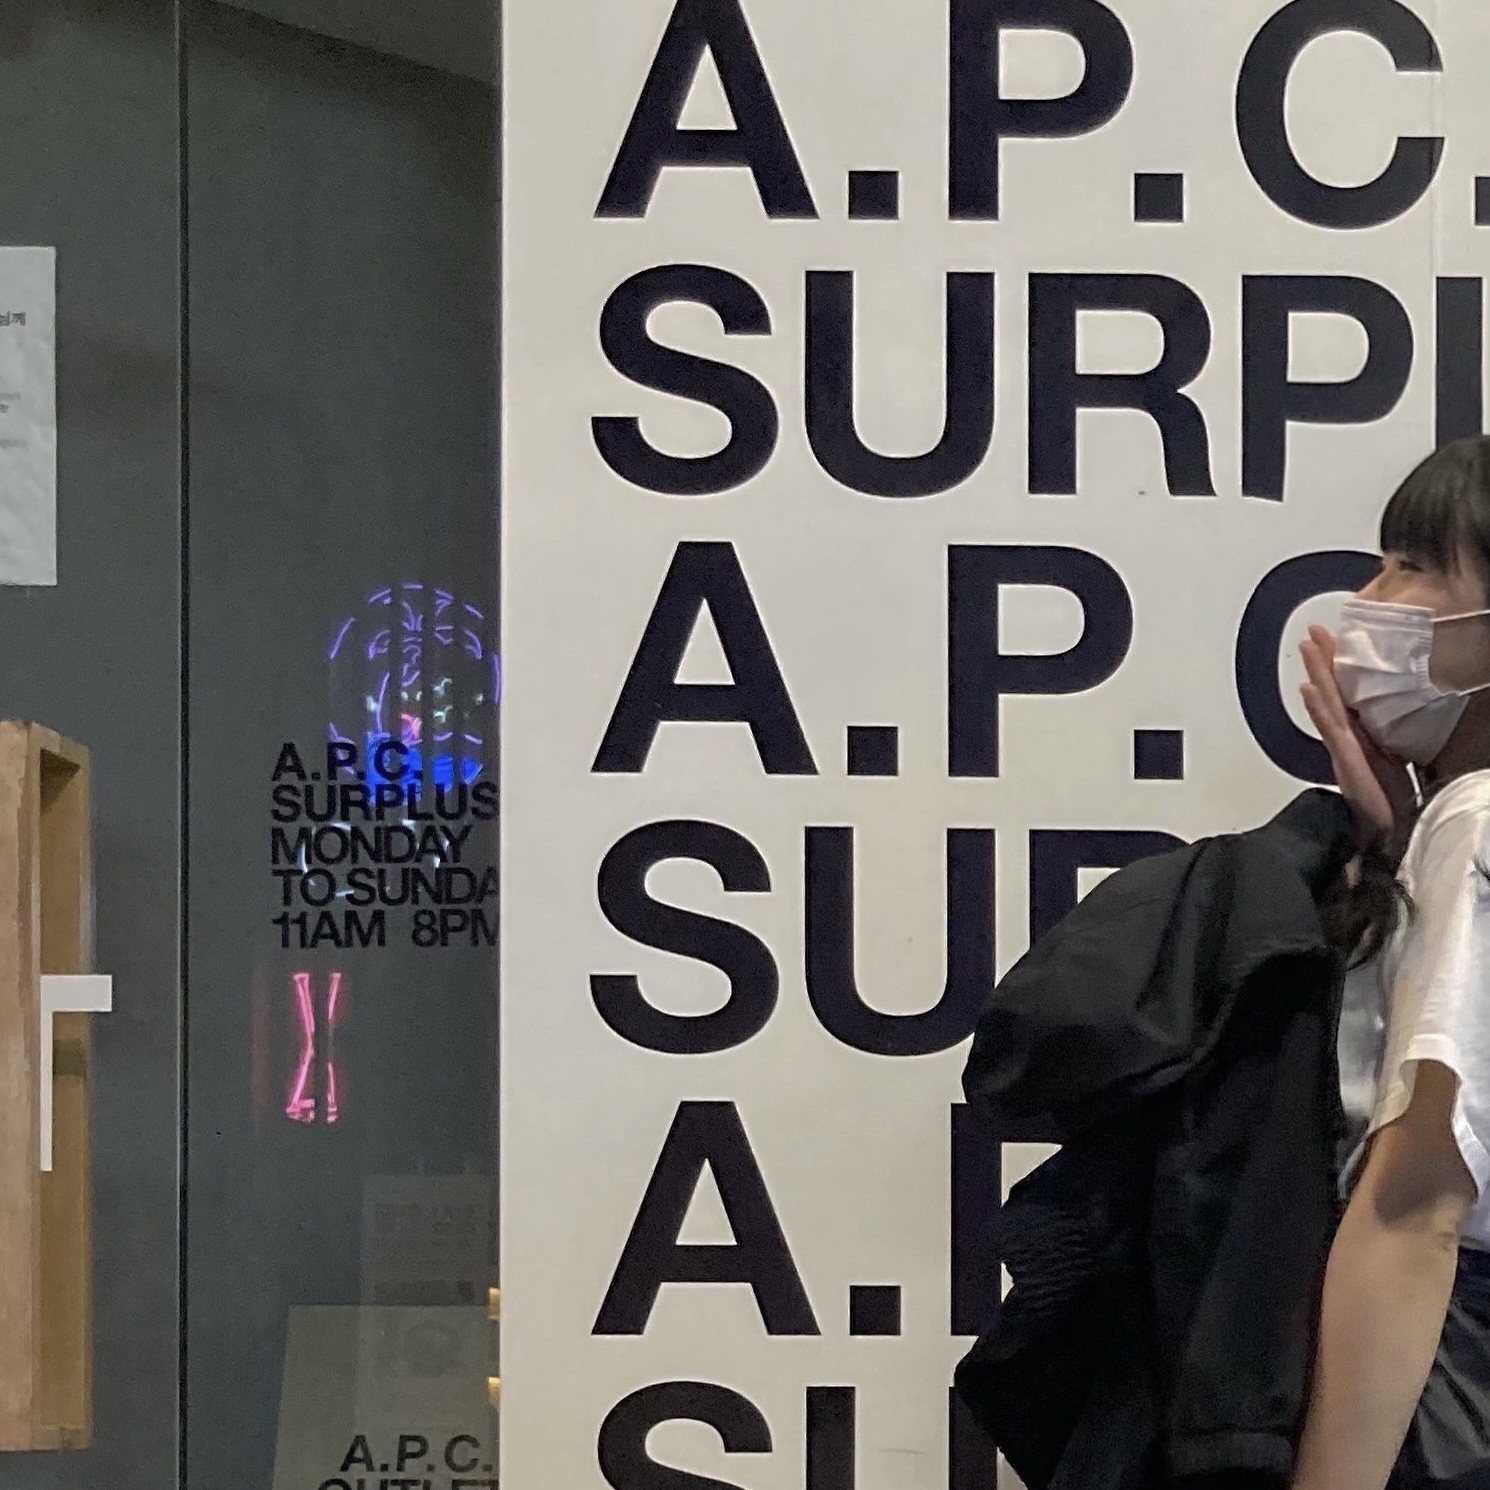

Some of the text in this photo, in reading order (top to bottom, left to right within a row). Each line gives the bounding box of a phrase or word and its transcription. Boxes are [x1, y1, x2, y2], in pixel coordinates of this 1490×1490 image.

[590, 541, 1384, 785] A.P.C
[271, 742, 423, 781] A.P.C.
[271, 781, 498, 822] SURPLUS
[271, 825, 471, 865] MONDAY
[271, 866, 498, 907] TO SUNDA
[271, 909, 386, 949] 11AM
[340, 1434, 492, 1472] A.P.C.
